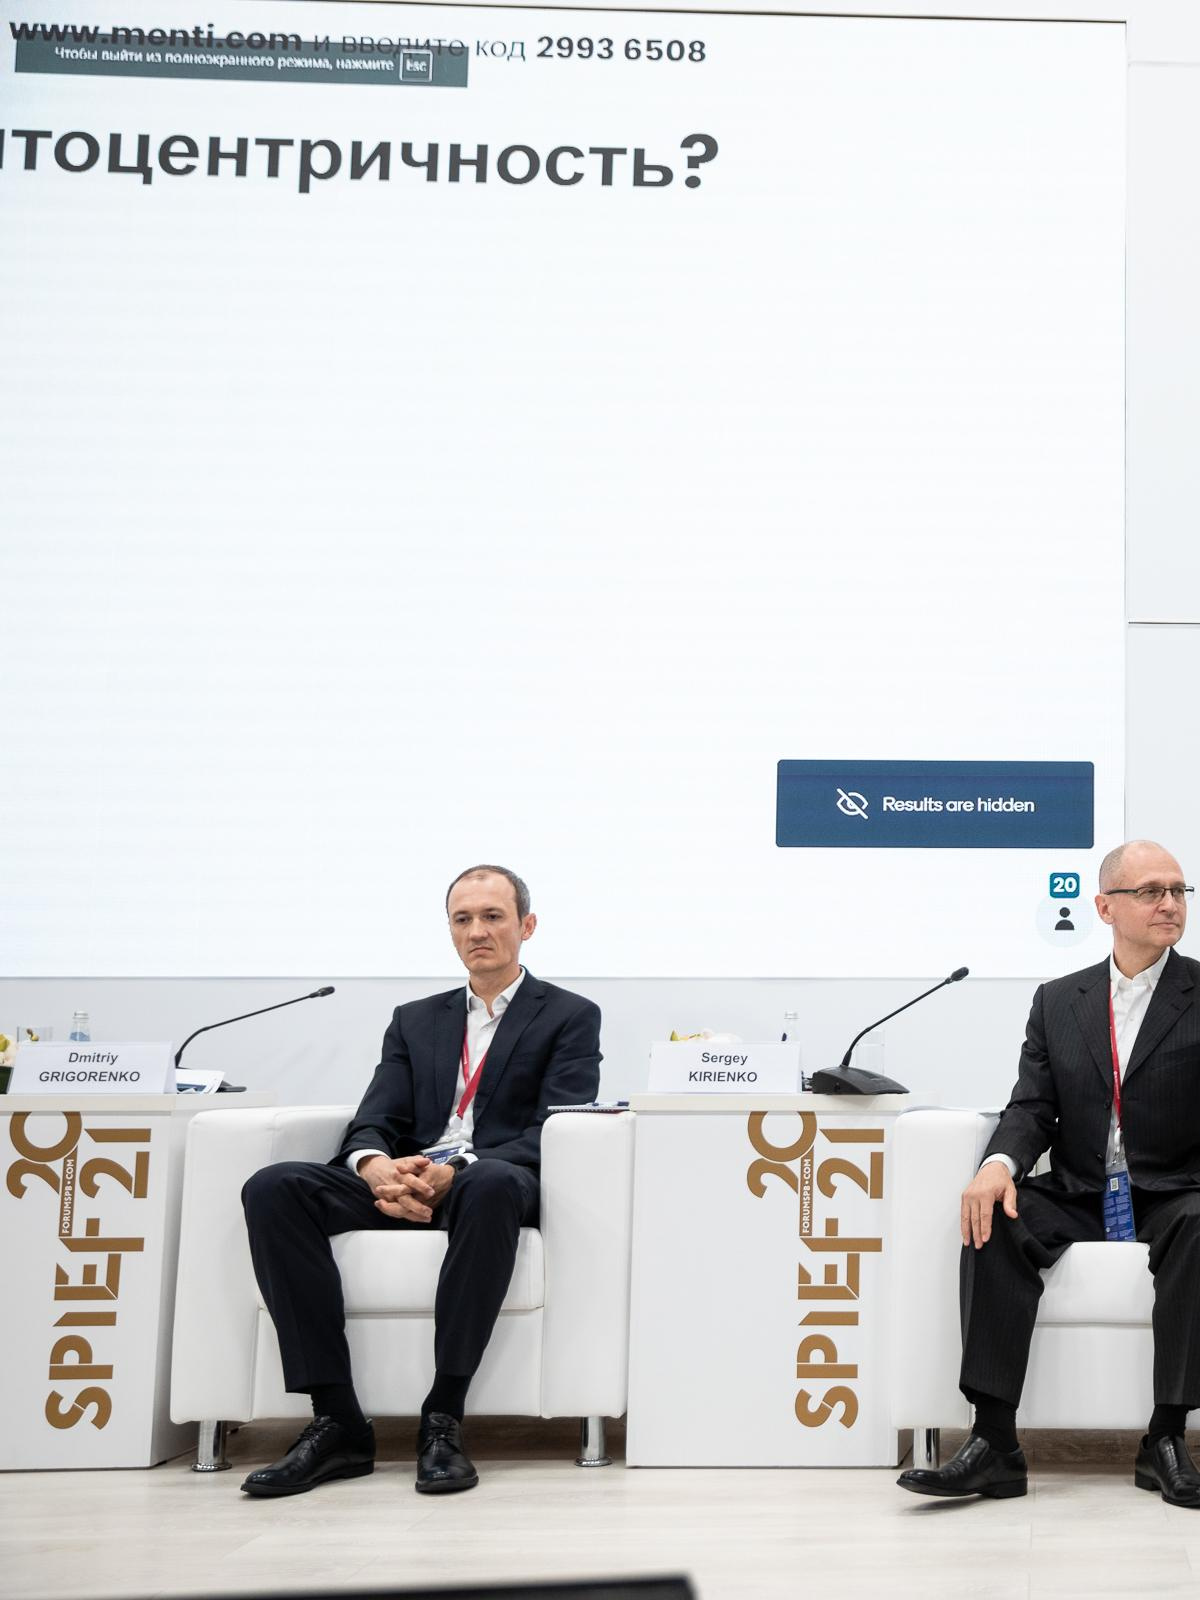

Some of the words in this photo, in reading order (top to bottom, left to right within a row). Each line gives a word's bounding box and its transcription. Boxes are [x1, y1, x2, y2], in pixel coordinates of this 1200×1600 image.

[9, 22, 302, 51] www.menti.com
[314, 35, 330, 51] и
[342, 36, 466, 58] введите
[476, 40, 526, 61] код
[537, 36, 613, 59] 2993
[624, 38, 706, 62] 6508
[55, 46, 98, 60] Чтобы
[101, 48, 142, 62] выйти
[146, 52, 162, 63] из
[336, 58, 394, 71] нажмите
[0, 129, 719, 193] тоцентричность?
[882, 797, 943, 812] Results
[946, 800, 975, 812] are
[977, 798, 1035, 813] hidden
[1053, 877, 1077, 893] 20
[68, 1051, 119, 1065] Dmitriy
[701, 1052, 748, 1066] Sergey
[39, 1071, 141, 1083] GRIGORENKO
[688, 1071, 758, 1082] KIRIENKO
[45, 1218, 145, 1430] SPIEF
[795, 1218, 882, 1429] SPIEF
